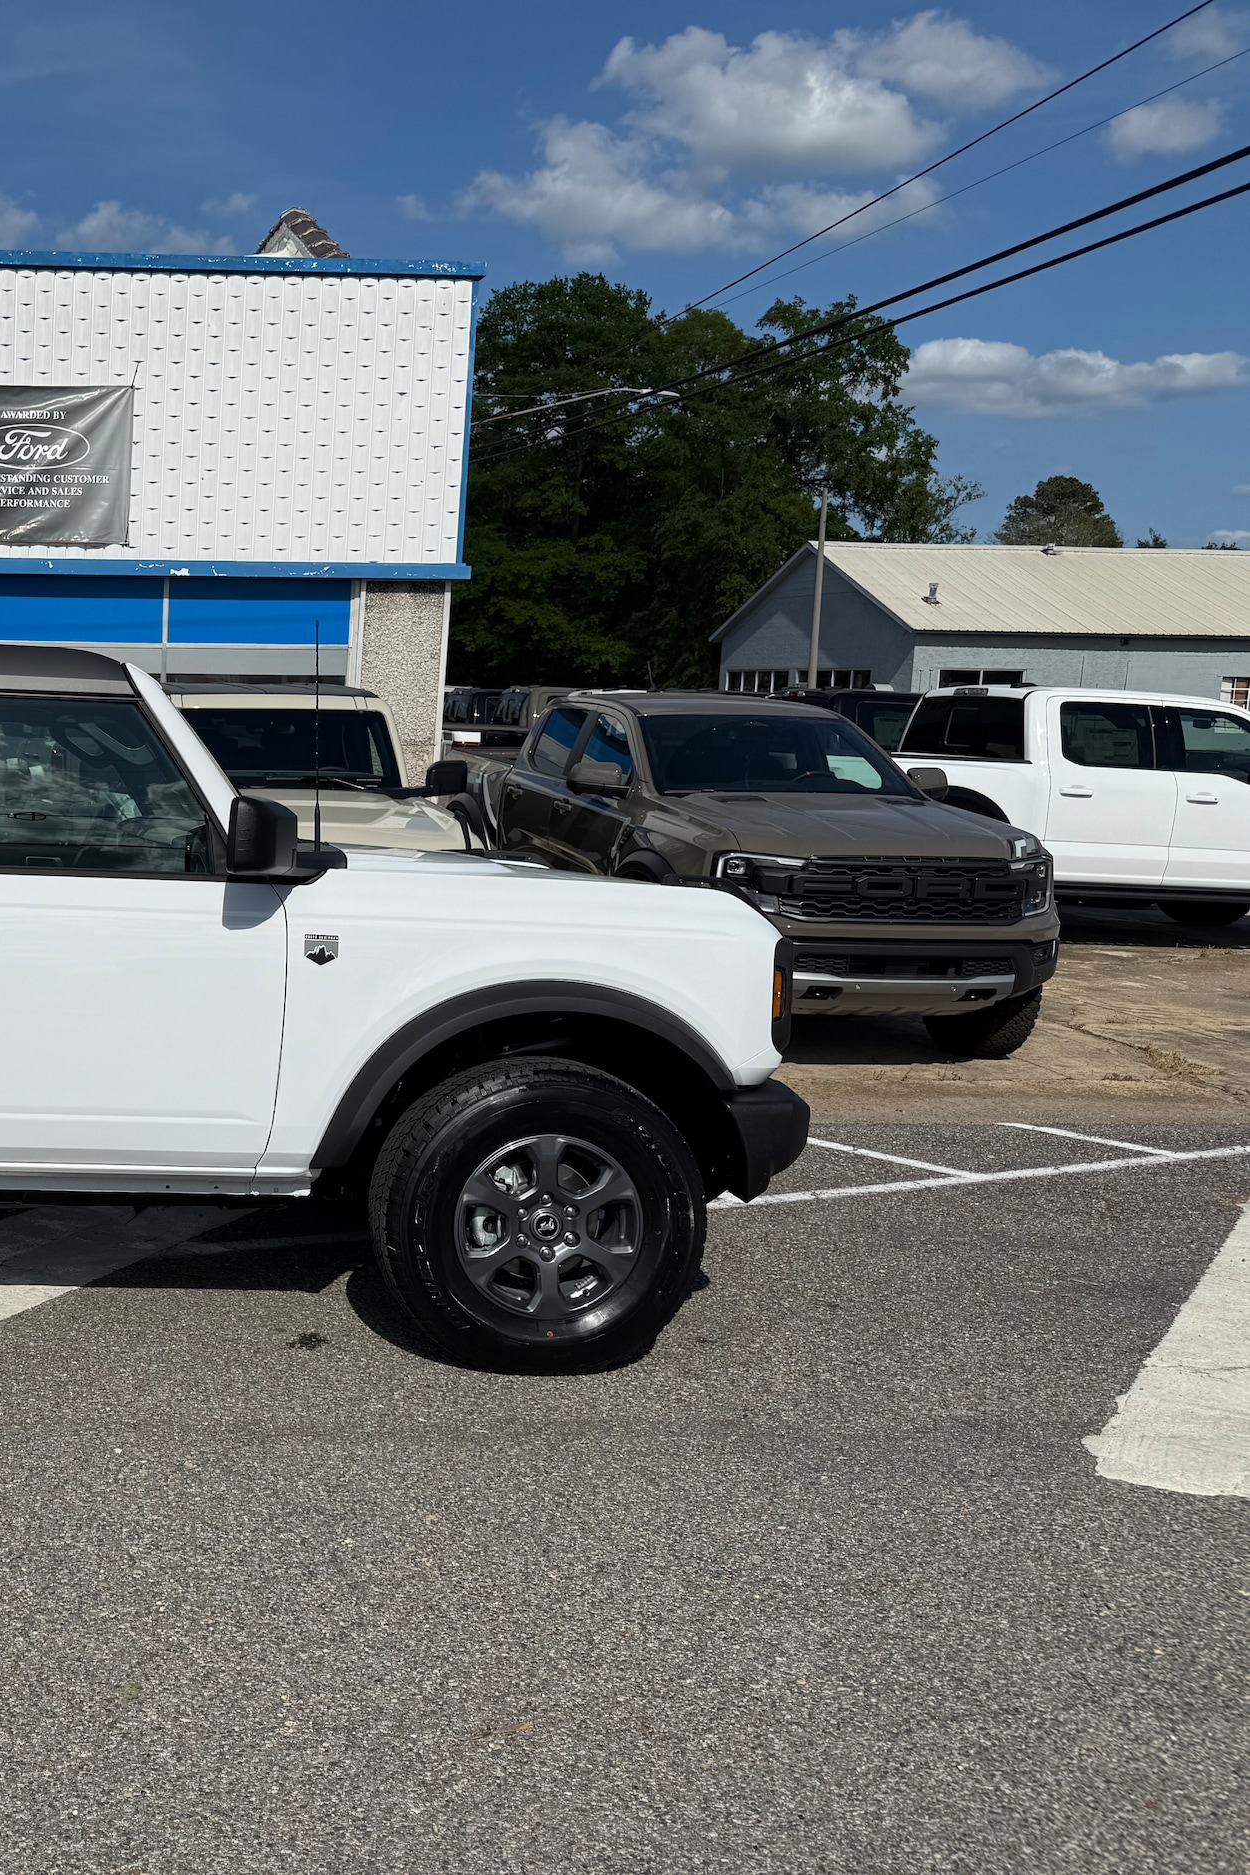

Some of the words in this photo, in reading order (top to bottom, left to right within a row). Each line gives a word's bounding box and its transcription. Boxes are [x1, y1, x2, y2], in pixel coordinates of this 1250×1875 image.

[0, 411, 50, 420] AWARDED
[53, 411, 67, 420] BY
[53, 475, 110, 484] CUSTOMER
[28, 487, 49, 496] AND
[51, 487, 83, 496] SALES
[792, 874, 1025, 900] FORD
